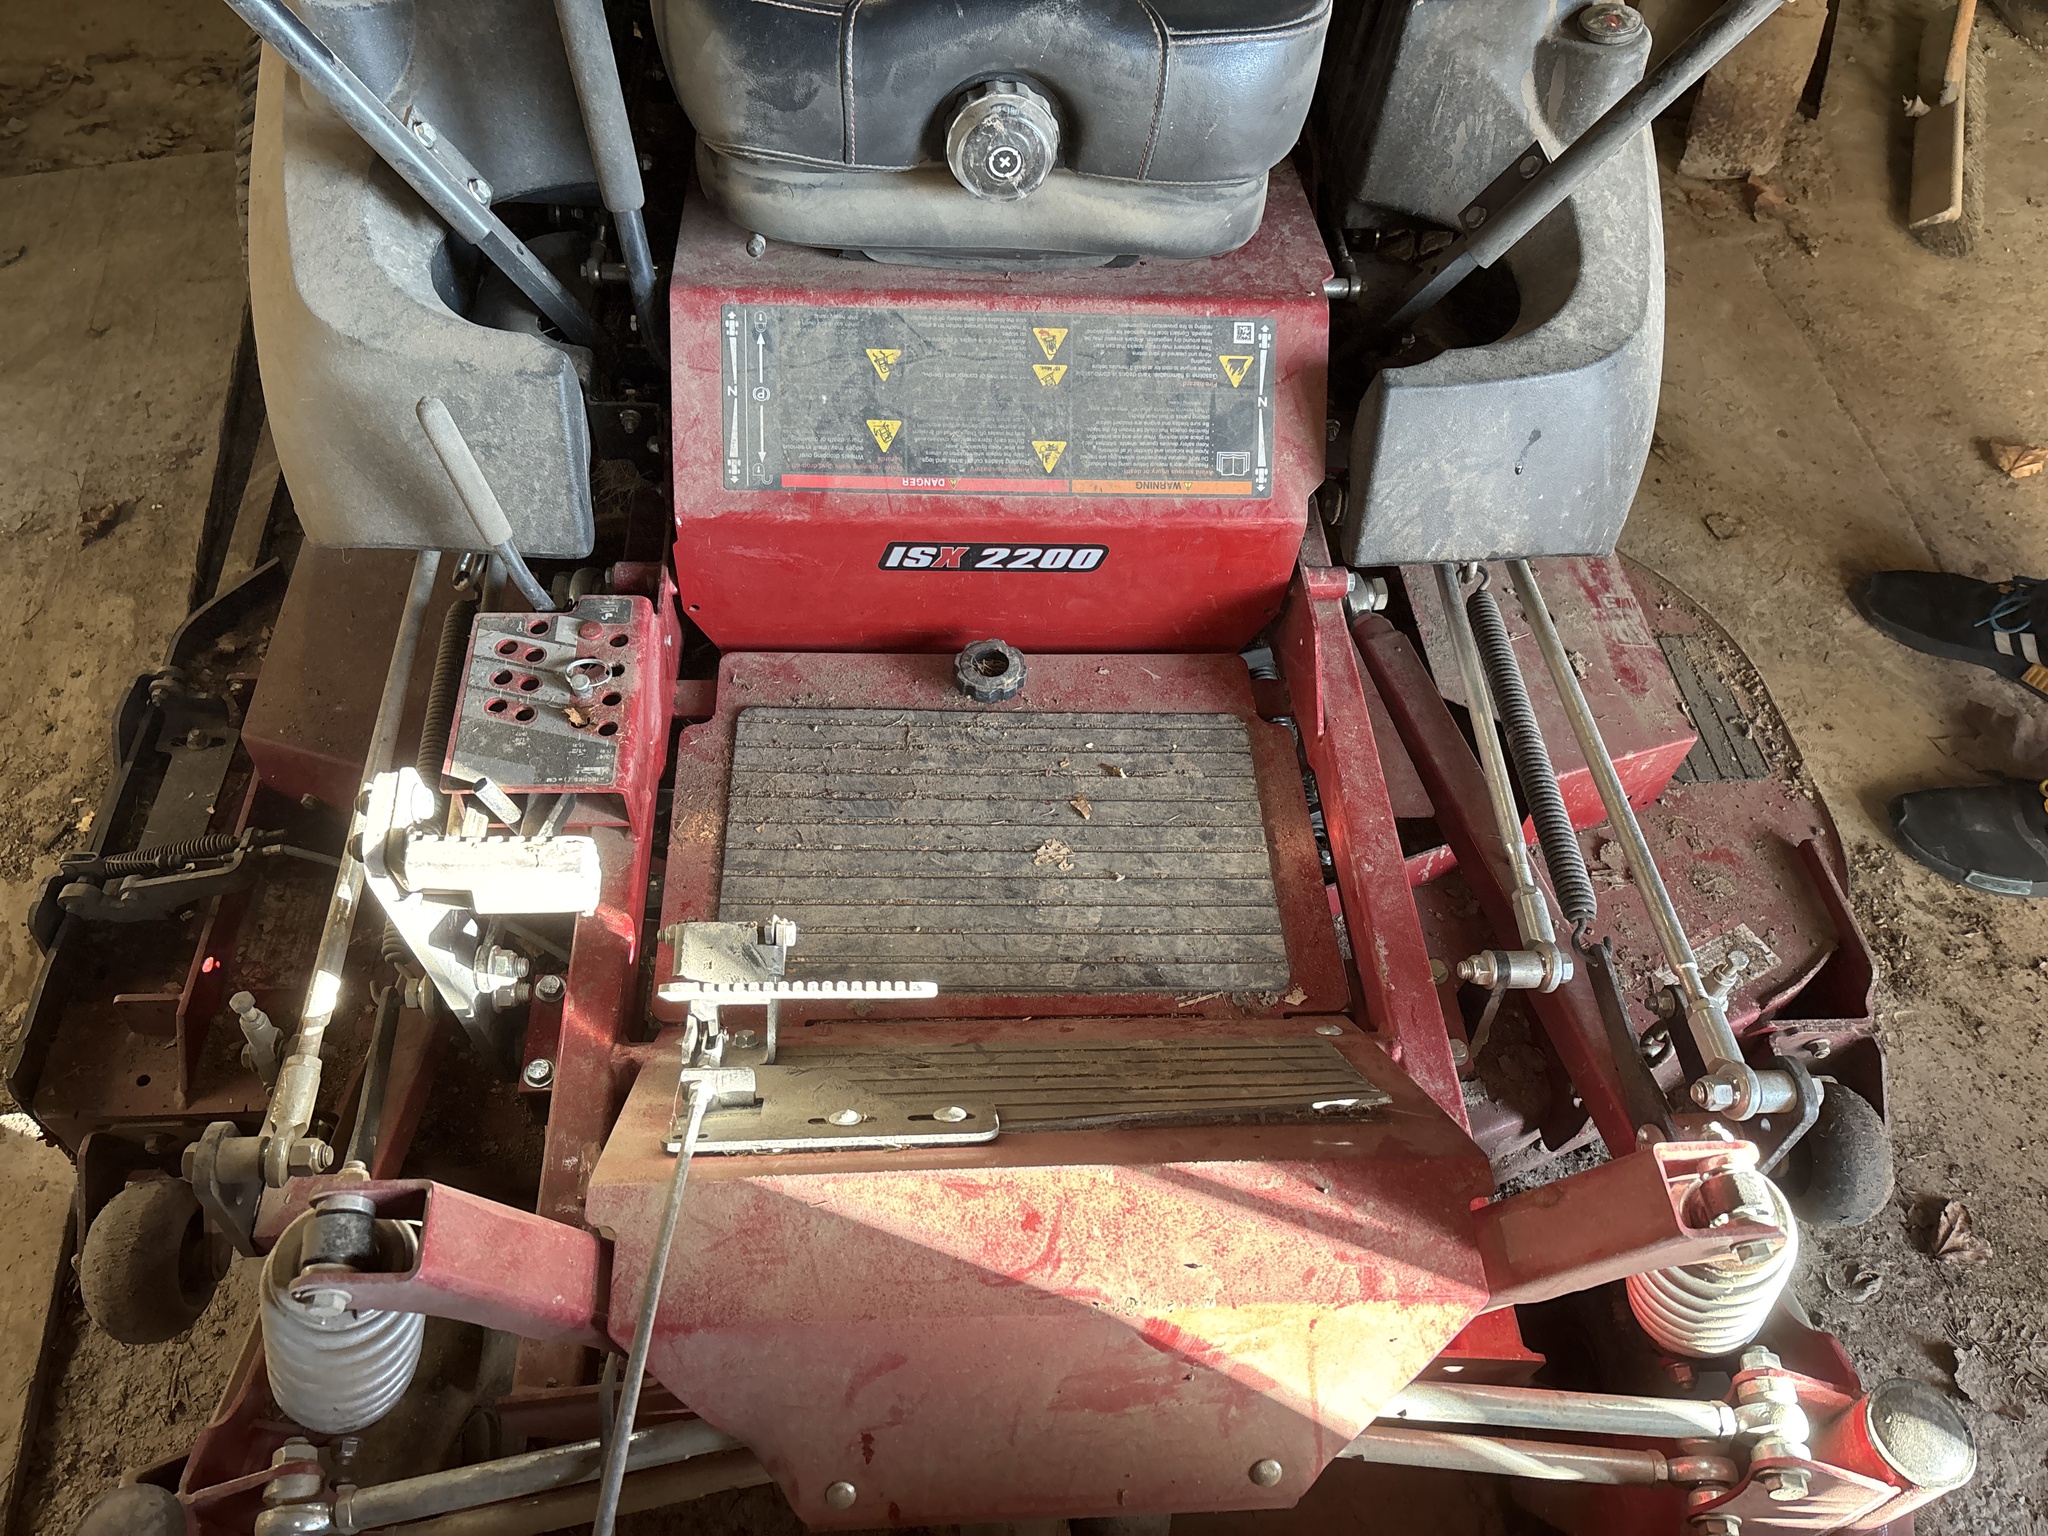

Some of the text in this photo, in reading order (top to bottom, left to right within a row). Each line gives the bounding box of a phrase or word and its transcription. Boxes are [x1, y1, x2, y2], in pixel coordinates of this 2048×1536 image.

[728, 386, 738, 396] N
[1258, 397, 1268, 407] N
[814, 452, 840, 460] dropping
[1152, 467, 1169, 475] injury
[902, 478, 945, 487] DANGER
[1136, 482, 1182, 490] WARNING
[885, 546, 1104, 569] ISX 2200
